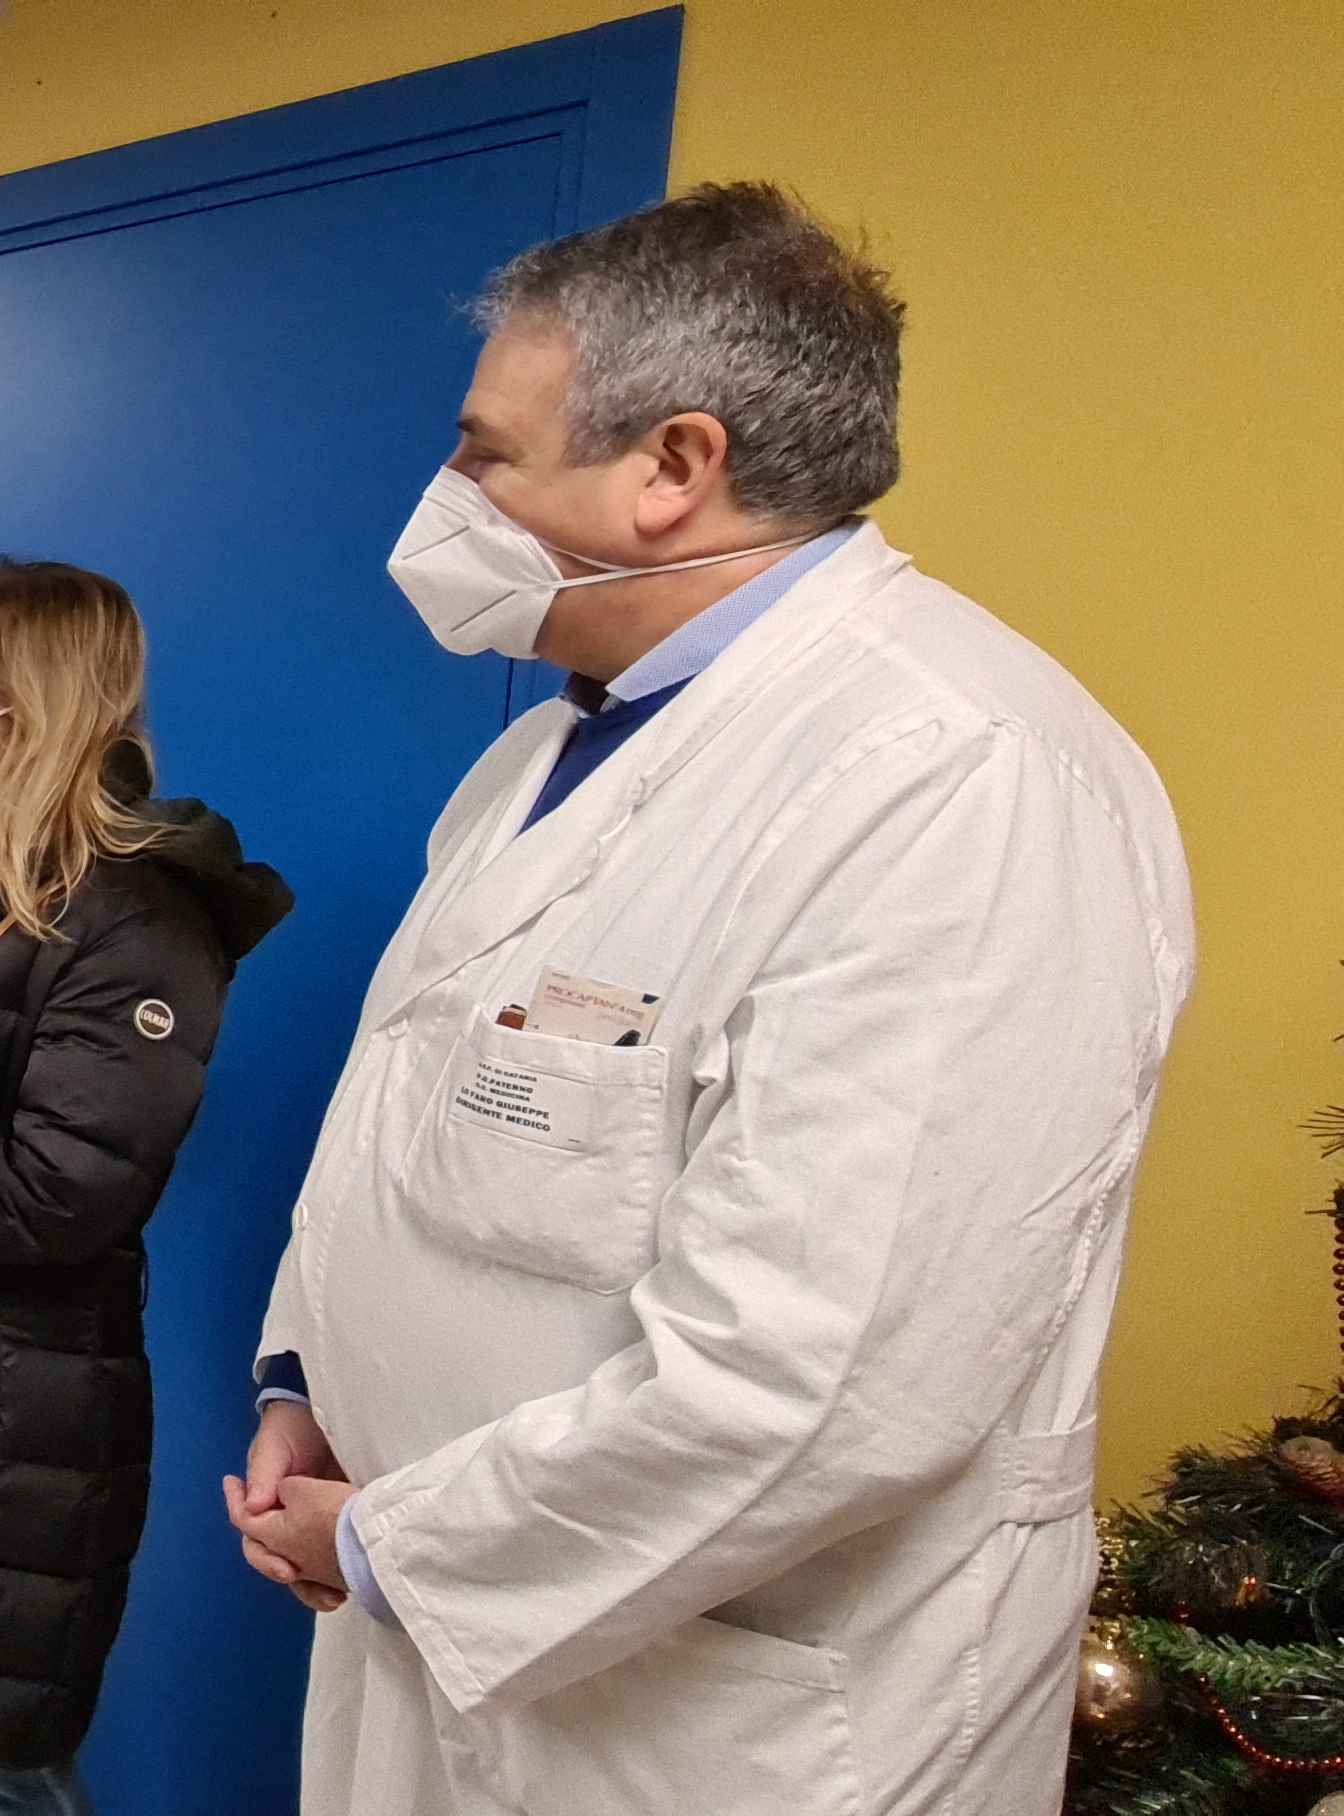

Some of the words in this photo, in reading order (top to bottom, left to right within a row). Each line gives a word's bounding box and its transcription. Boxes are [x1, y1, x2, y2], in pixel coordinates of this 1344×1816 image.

[455, 1096, 503, 1120] DIRIGENTE
[505, 1114, 551, 1132] MEDICO
[496, 1100, 550, 1120] GIUSEPPE
